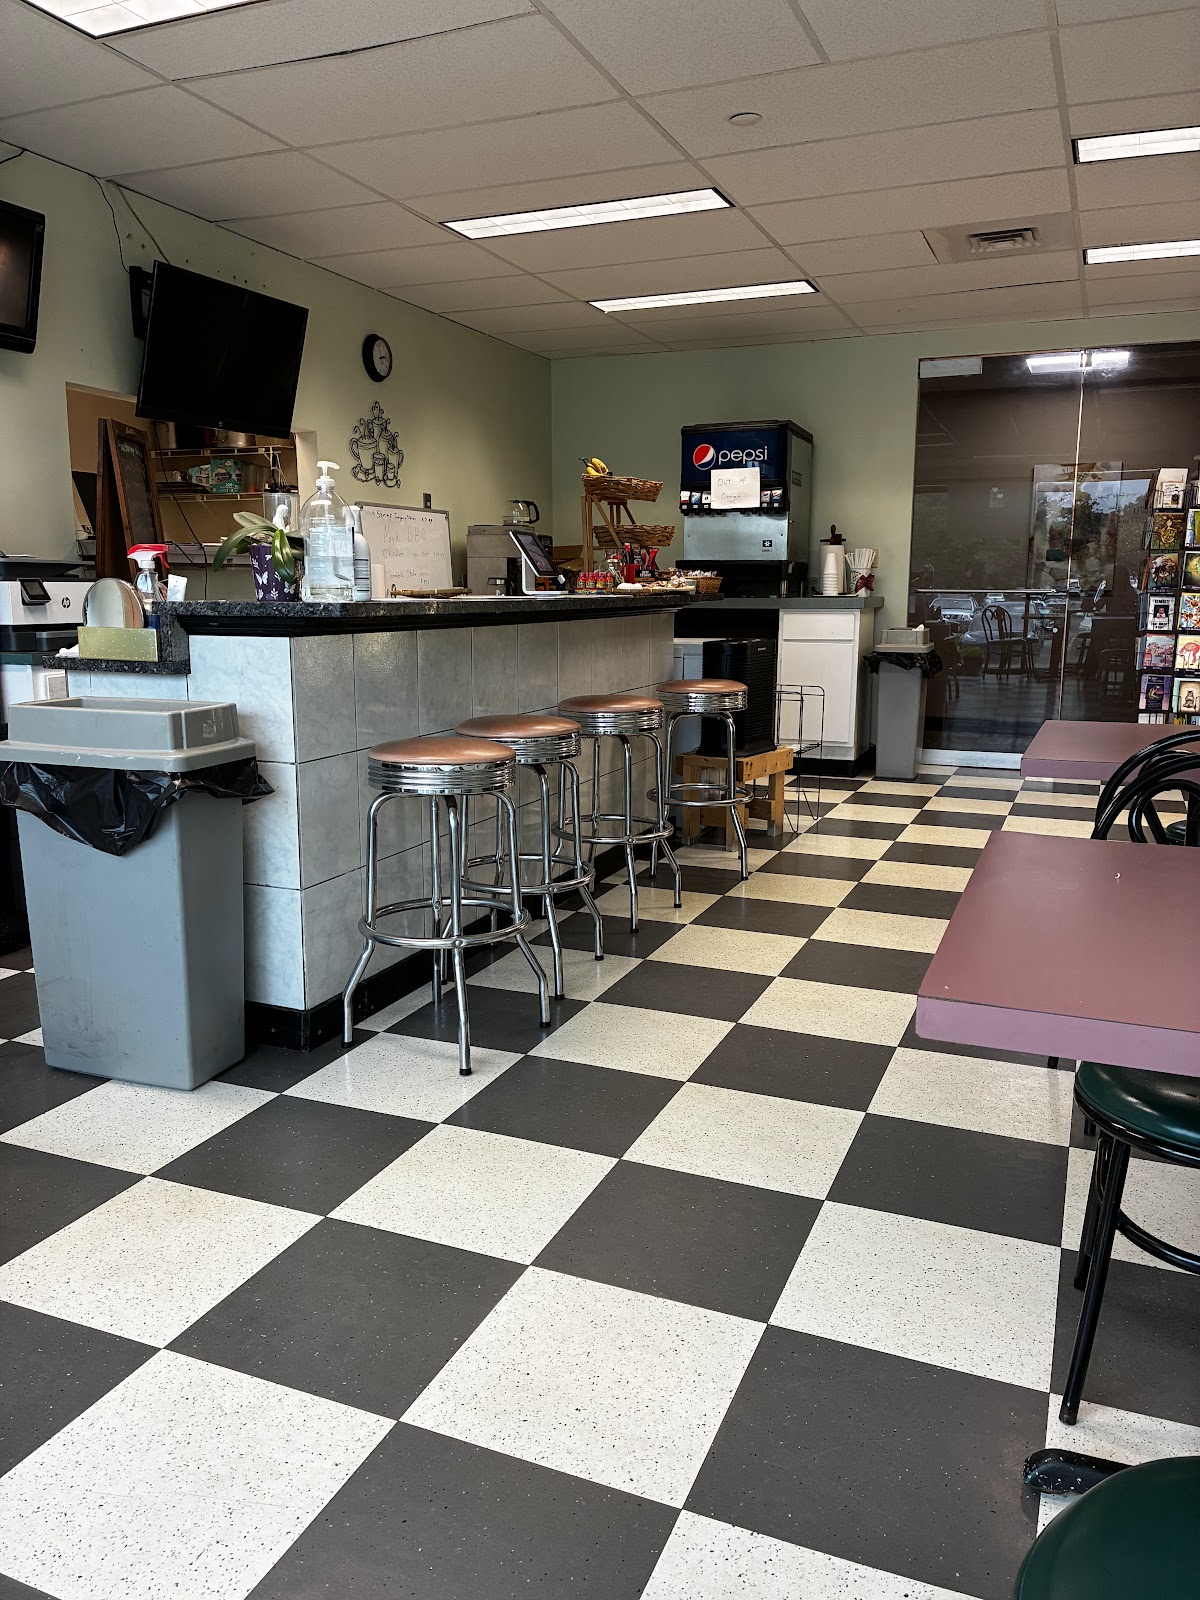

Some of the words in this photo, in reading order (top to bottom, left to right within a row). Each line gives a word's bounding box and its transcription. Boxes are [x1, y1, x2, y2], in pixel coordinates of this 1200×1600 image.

[719, 446, 767, 465] pepsi
[717, 478, 731, 487] Out
[383, 524, 401, 543] Pork
[407, 525, 427, 543] BBQ
